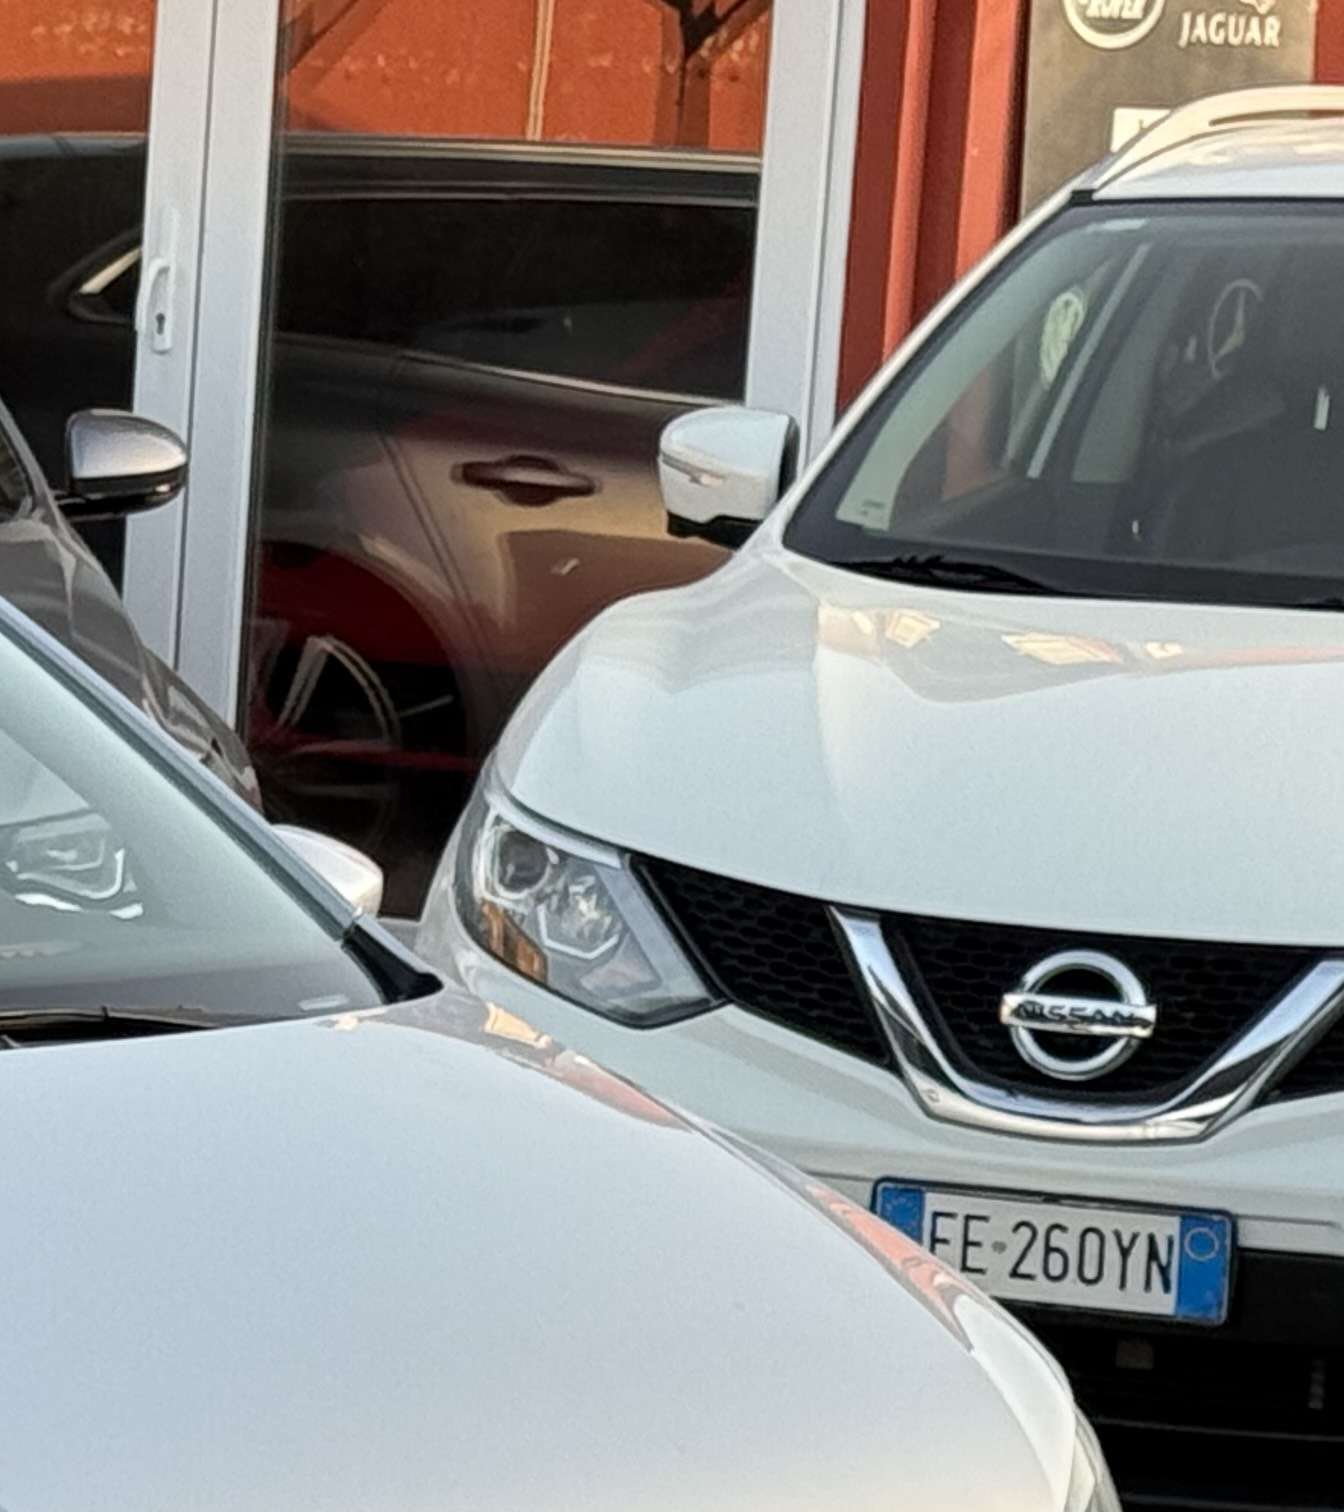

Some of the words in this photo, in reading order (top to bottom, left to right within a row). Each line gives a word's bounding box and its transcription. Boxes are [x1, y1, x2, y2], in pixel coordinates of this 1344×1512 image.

[1178, 10, 1280, 48] JAGUAR
[1015, 1000, 1138, 1026] NISSAN
[1009, 1220, 1175, 1294] 260YN
